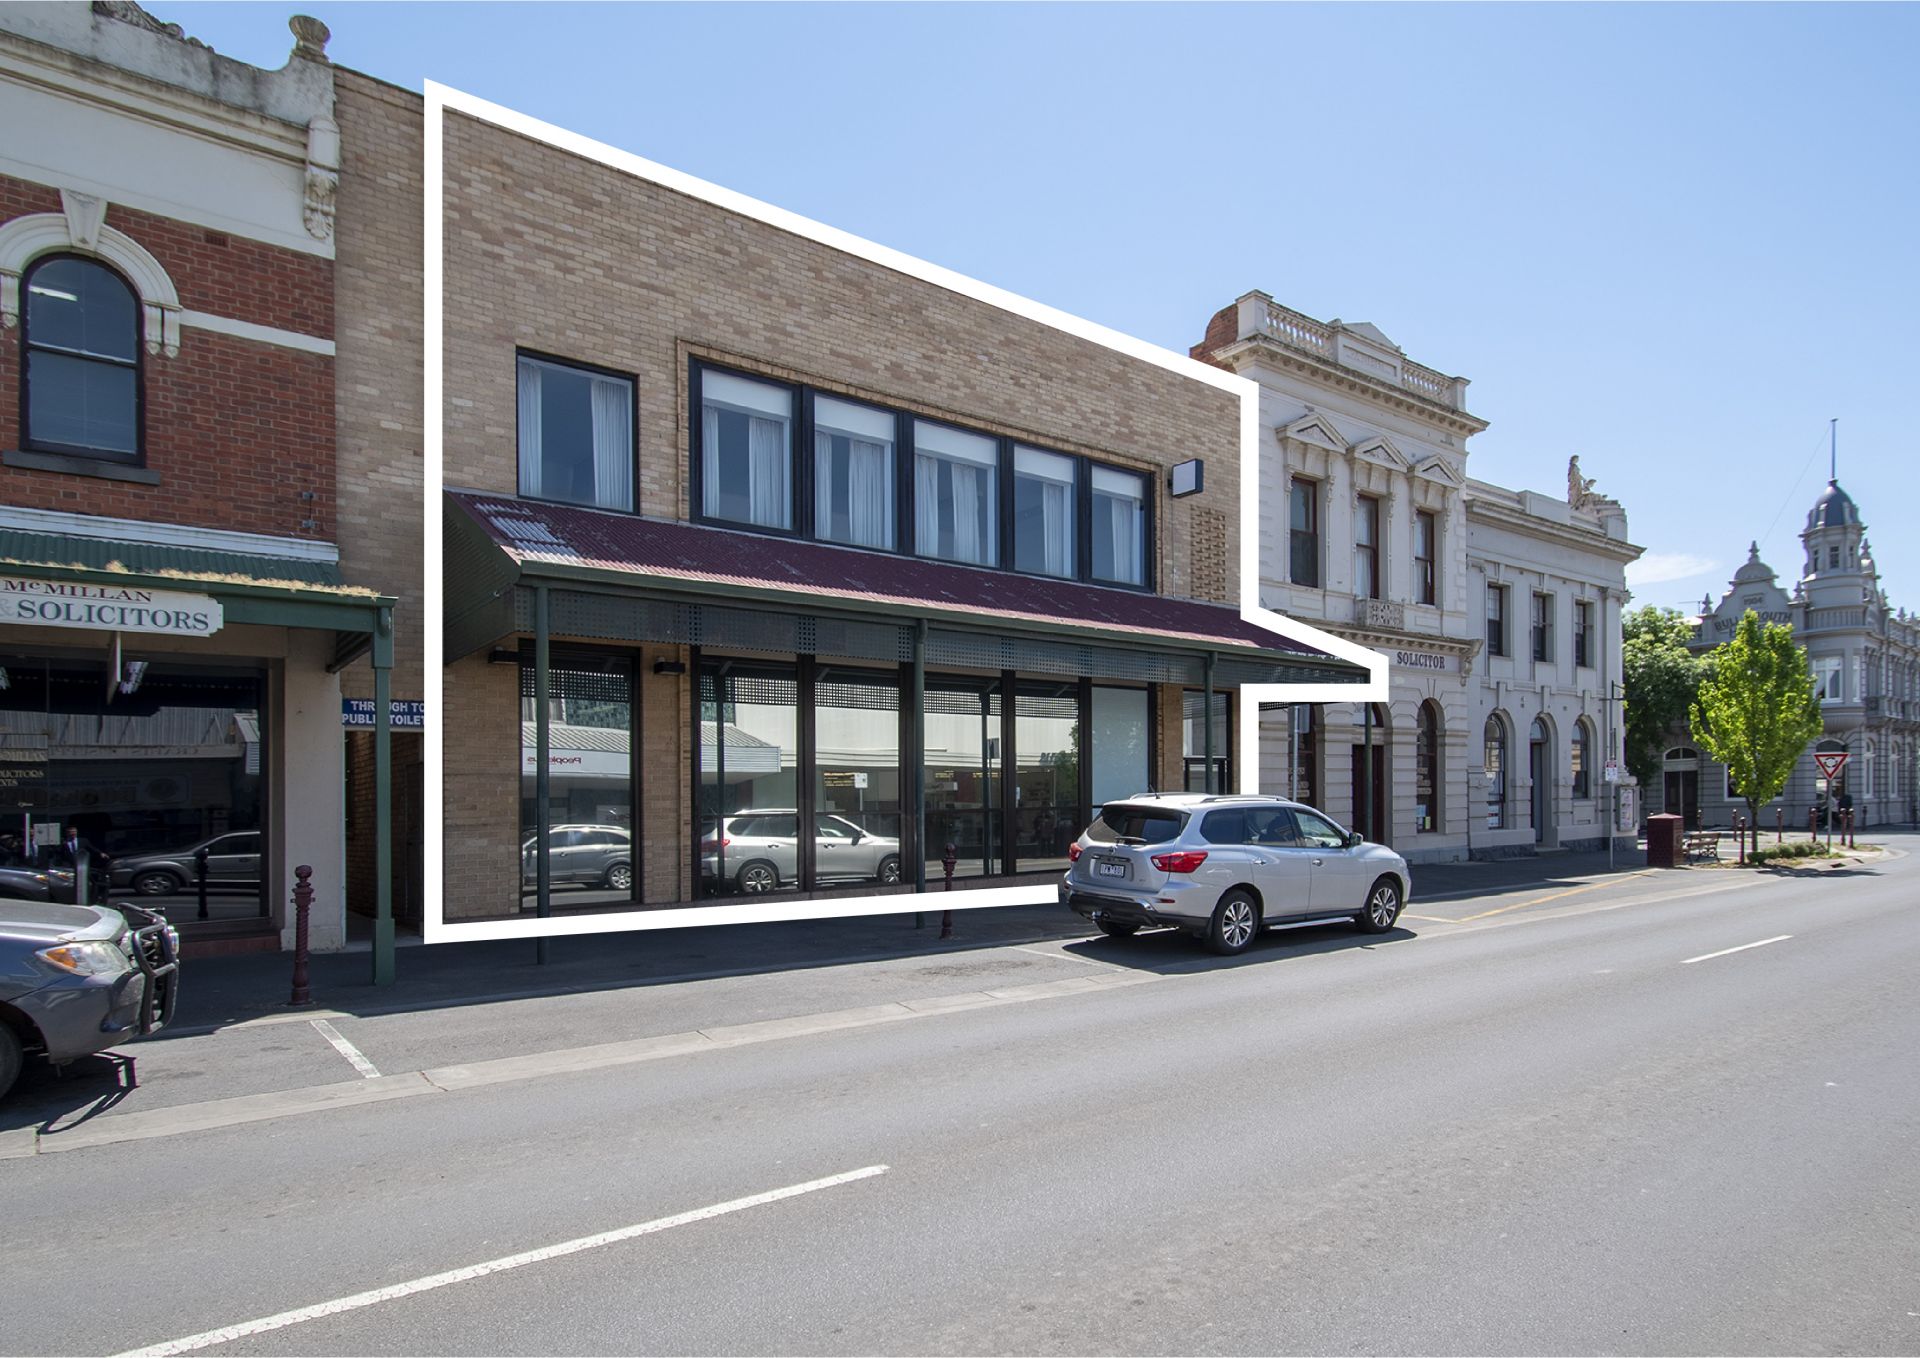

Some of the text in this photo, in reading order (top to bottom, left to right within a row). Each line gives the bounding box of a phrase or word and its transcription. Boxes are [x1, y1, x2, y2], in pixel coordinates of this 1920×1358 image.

[3, 580, 152, 602] McMILLAN
[17, 599, 209, 631] SOLICITORS
[1758, 611, 1792, 622] OUTH
[1397, 651, 1445, 669] SOLICITOR
[351, 701, 408, 712] THRGH
[342, 713, 376, 724] PUBLI
